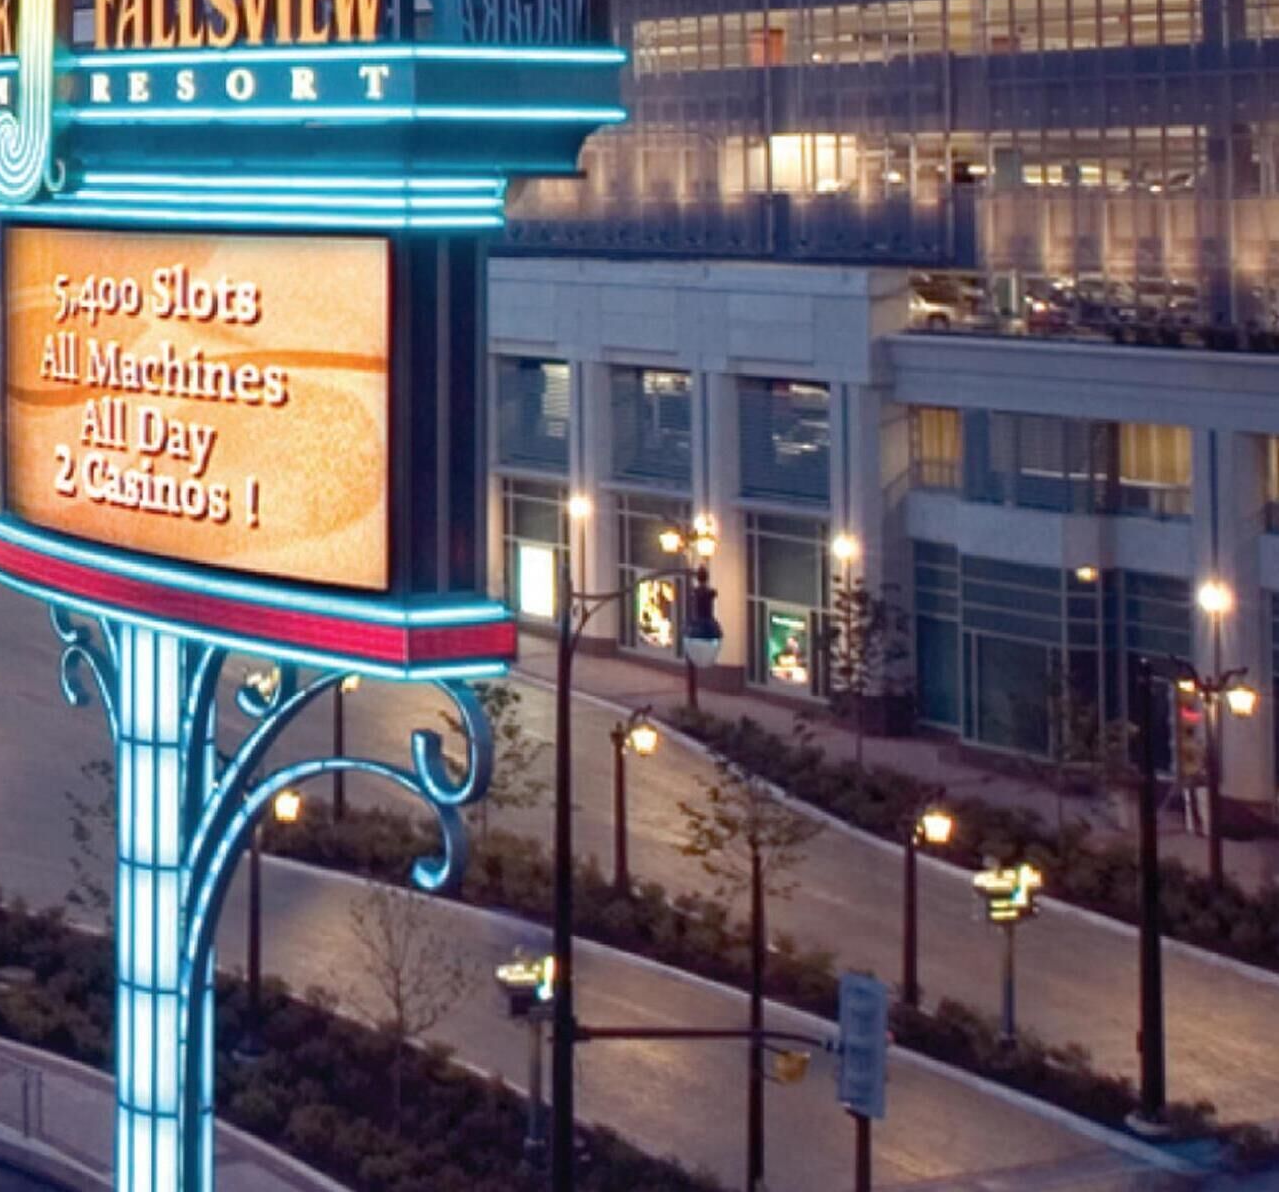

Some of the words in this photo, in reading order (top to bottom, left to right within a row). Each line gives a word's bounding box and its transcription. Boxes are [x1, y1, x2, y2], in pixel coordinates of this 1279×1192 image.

[91, 65, 389, 103] RESORT
[150, 263, 260, 323] Slots
[41, 331, 78, 382] All
[87, 339, 288, 405] Machines
[82, 396, 127, 449] All
[136, 404, 216, 473] Day
[54, 445, 76, 496] 2
[81, 456, 229, 521] Casinos
